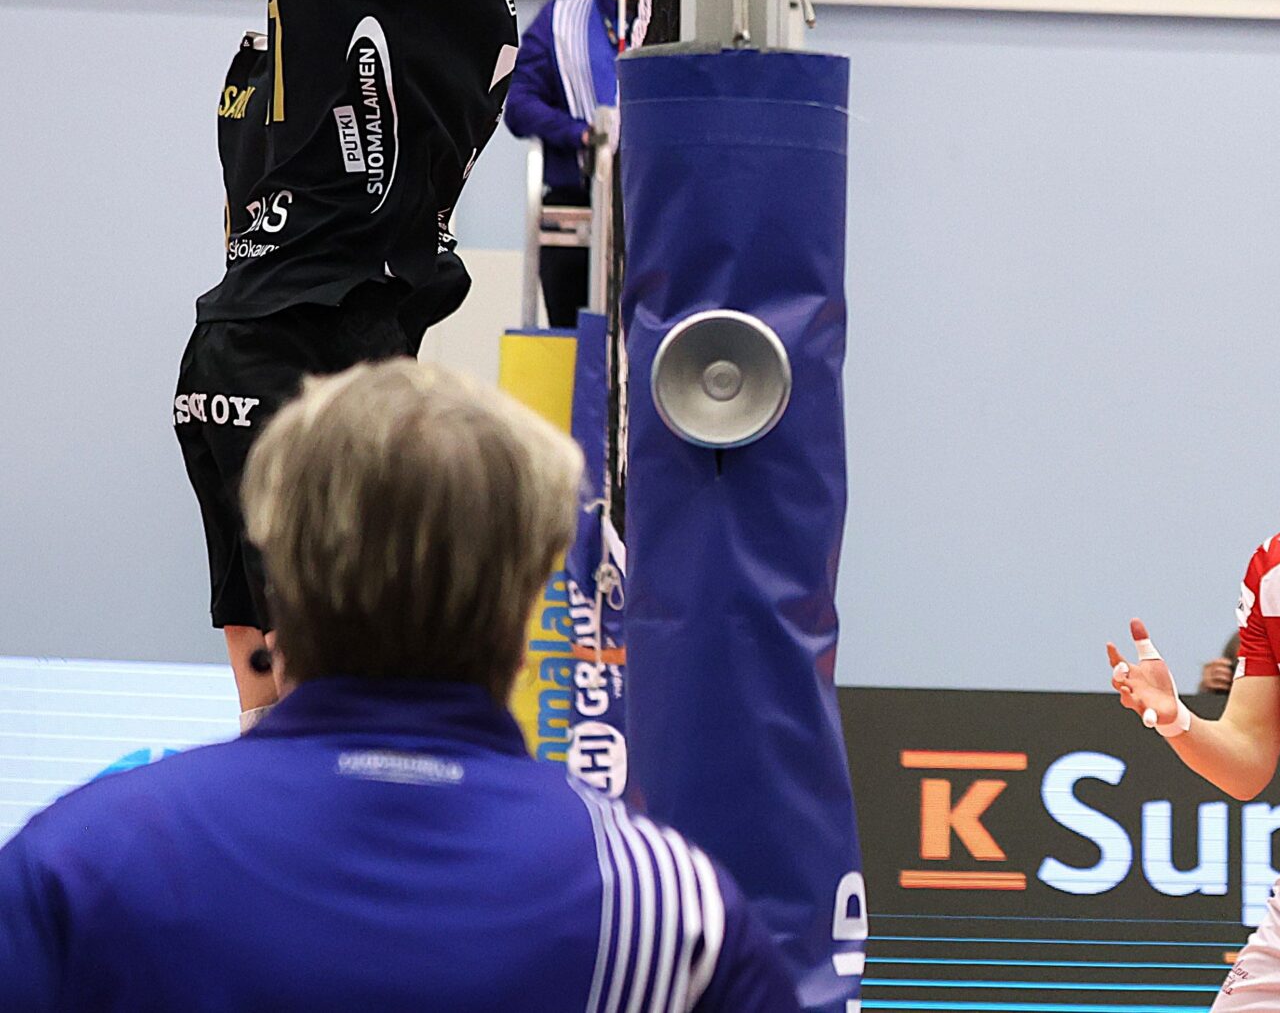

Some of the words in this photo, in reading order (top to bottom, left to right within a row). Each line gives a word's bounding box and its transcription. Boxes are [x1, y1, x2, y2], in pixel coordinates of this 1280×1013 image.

[338, 114, 361, 162] PUTKI
[358, 48, 385, 195] SUOMALAINEN
[919, 777, 1007, 861] K
